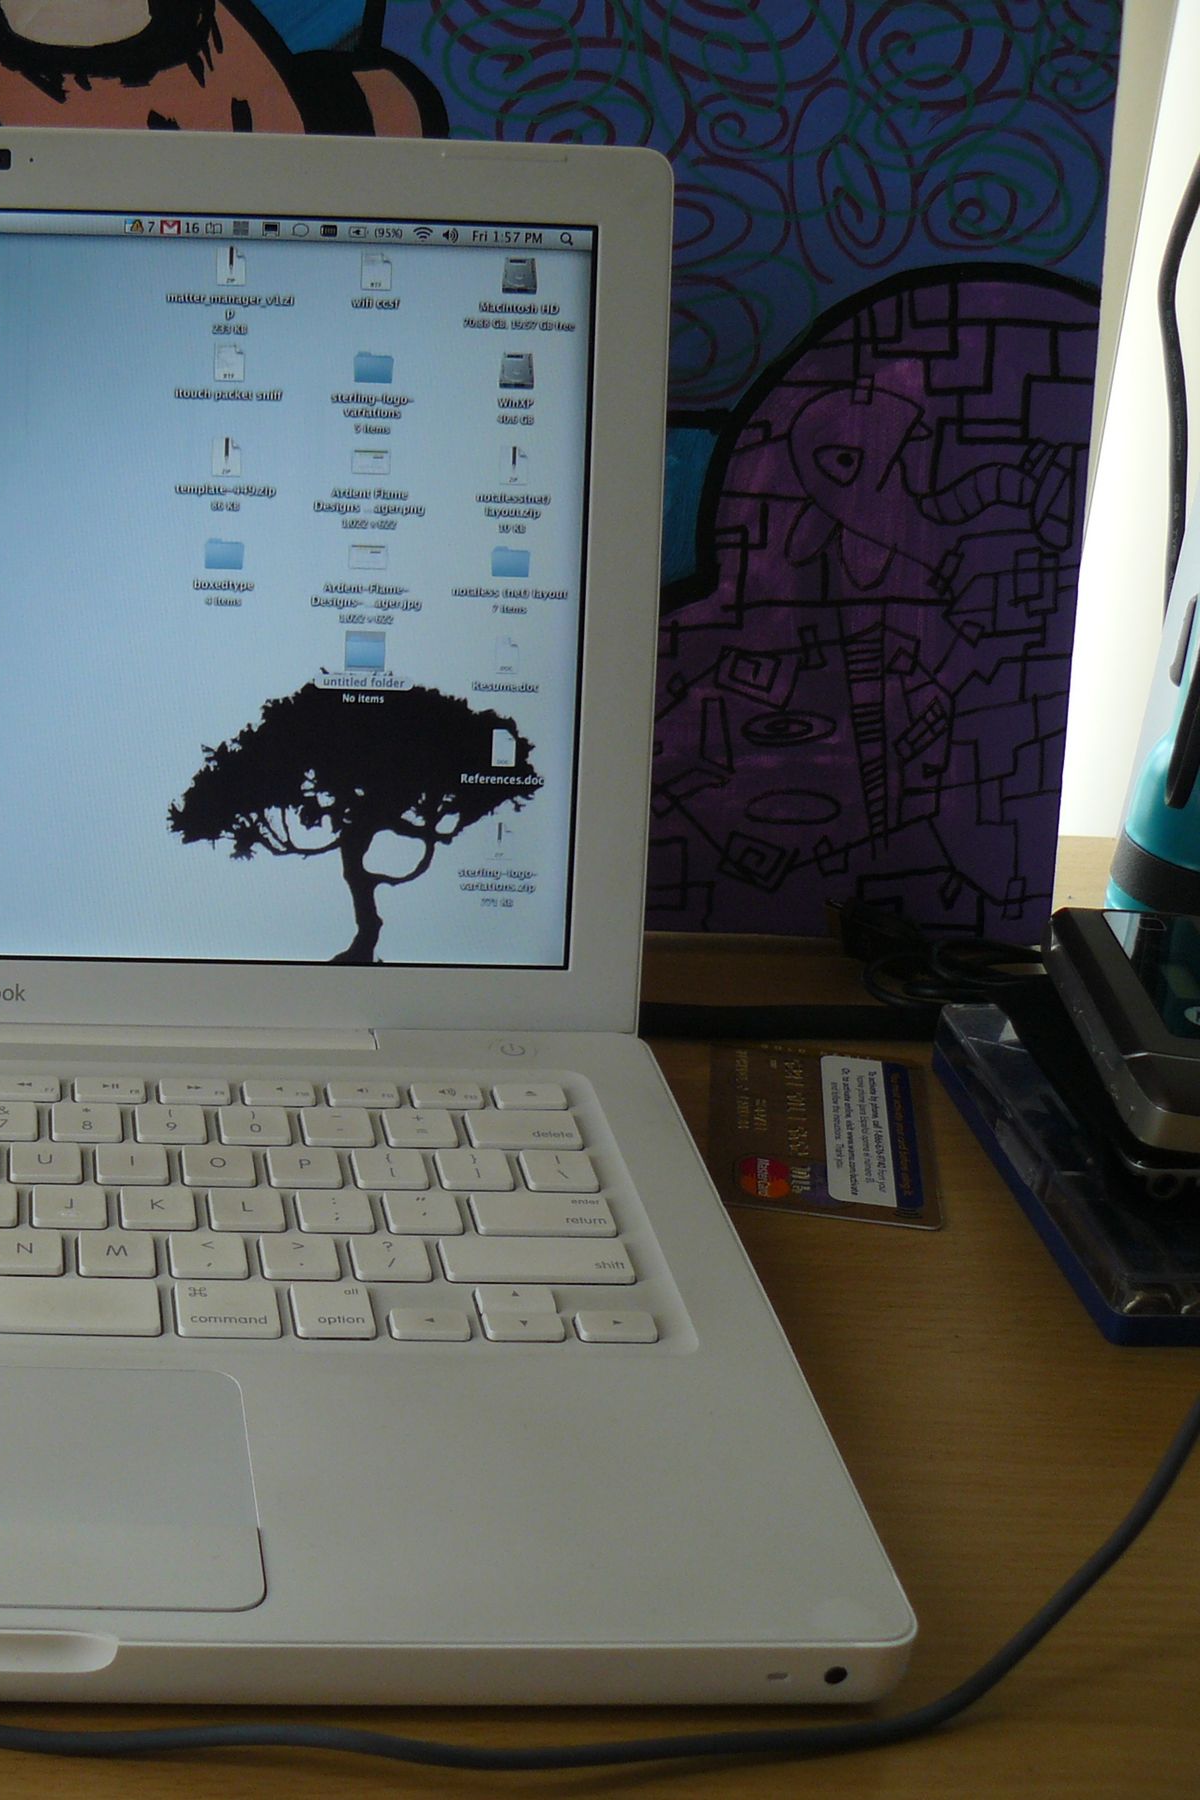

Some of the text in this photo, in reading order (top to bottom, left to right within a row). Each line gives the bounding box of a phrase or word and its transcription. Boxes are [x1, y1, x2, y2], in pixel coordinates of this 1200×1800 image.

[148, 222, 155, 233] 7
[185, 223, 200, 234] 16
[374, 228, 403, 240] (95%)
[472, 231, 543, 244] Fri 1:57 PM
[479, 302, 560, 315] Macintosh HD
[233, 325, 248, 335] KB
[214, 389, 252, 402] packet
[497, 398, 535, 409] WinXP
[343, 408, 402, 419] variations
[363, 424, 390, 435] items
[331, 487, 409, 501] Ardent Flame
[313, 501, 360, 514] Designs
[193, 579, 255, 592] boxedtype
[532, 589, 568, 601] layout
[213, 597, 242, 607] items
[501, 606, 528, 615] items
[323, 677, 405, 688] untitled folder
[342, 694, 385, 704] No items
[460, 773, 545, 785] References.doc
[81, 1120, 94, 1131] 8
[165, 1121, 178, 1132] 9
[531, 1128, 574, 1139] delete
[37, 1153, 53, 1165] U
[209, 1157, 227, 1169] O
[298, 1158, 312, 1170] P
[64, 1197, 74, 1210] J
[150, 1198, 166, 1211] K
[241, 1200, 254, 1213] L
[570, 1198, 600, 1206] enter
[565, 1216, 608, 1225] return
[16, 1242, 33, 1255] N
[105, 1244, 128, 1257] M
[594, 1260, 625, 1270] shift
[190, 1314, 268, 1325] command
[317, 1315, 366, 1326] option
